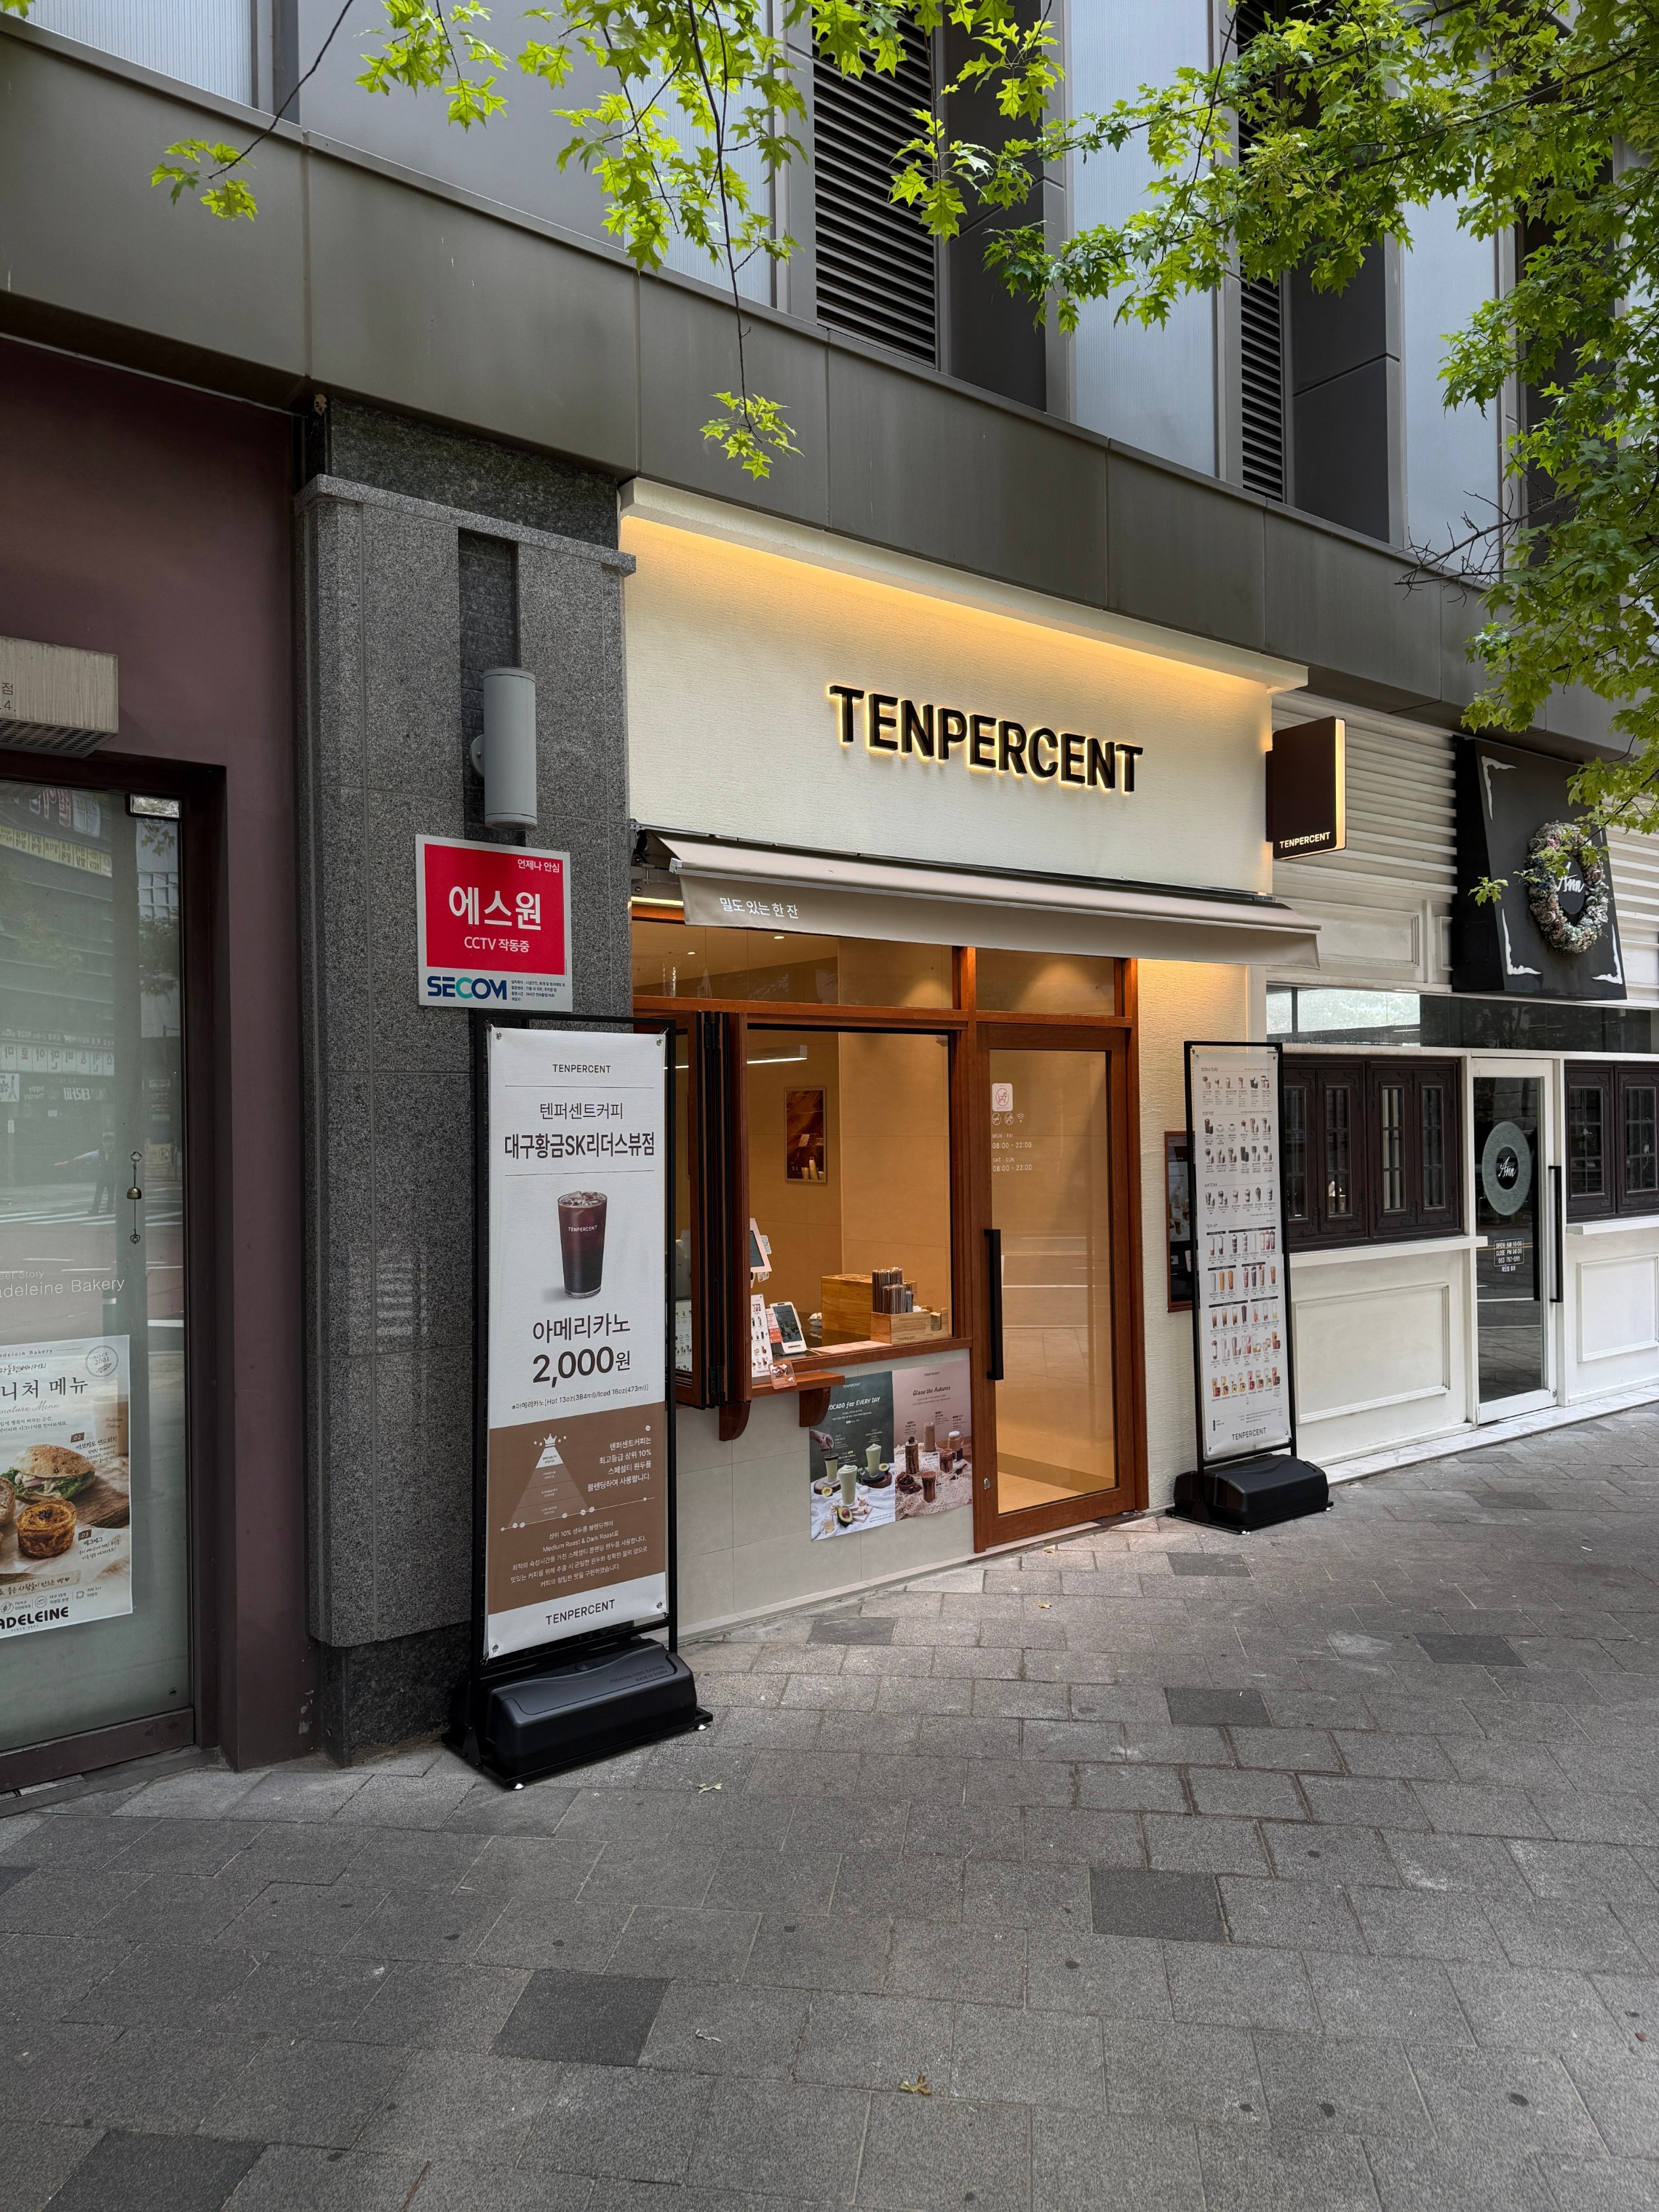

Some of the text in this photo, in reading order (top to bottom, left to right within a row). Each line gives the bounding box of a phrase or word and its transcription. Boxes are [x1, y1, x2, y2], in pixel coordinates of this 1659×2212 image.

[829, 684, 1144, 793] TENPERCENT
[1279, 831, 1331, 849] TENPERCENT
[517, 859, 560, 873] 언제나 안심
[449, 886, 541, 931] 에스원
[719, 897, 799, 919] 밀도 있는 한 잔
[464, 936, 530, 952] CCTV 작동중
[426, 975, 508, 1000] SECOM
[552, 1064, 611, 1074] TENPERCENT
[540, 1102, 623, 1120] 텐퍼센트커피
[504, 1131, 655, 1159] 대구황금SK리더스뷰점
[1498, 1156, 1516, 1178] Ann
[568, 1225, 597, 1233] TENPERCENT
[18, 1270, 44, 1279] Story
[0, 1278, 125, 1298] deleine Bakery
[533, 1313, 631, 1343] 아메리카노
[95, 1357, 110, 1365] 2001
[533, 1346, 631, 1388] 2,000원
[1, 1377, 88, 1401] 니처 메뉴
[856, 1398, 871, 1406] EVERY
[1232, 1427, 1267, 1441] TENPERCENT
[610, 1437, 651, 1450] 텐퍼센트커피는
[599, 1449, 652, 1464] 최고등급 상위 10%
[608, 1460, 652, 1474] 스페셜티 원두를
[587, 1473, 652, 1492] 블렌딩하여 사용합니다.
[542, 1543, 565, 1552] Medium
[565, 1539, 580, 1548] Roast
[586, 1535, 599, 1543] Dark
[546, 1599, 616, 1626] TENPERCENT
